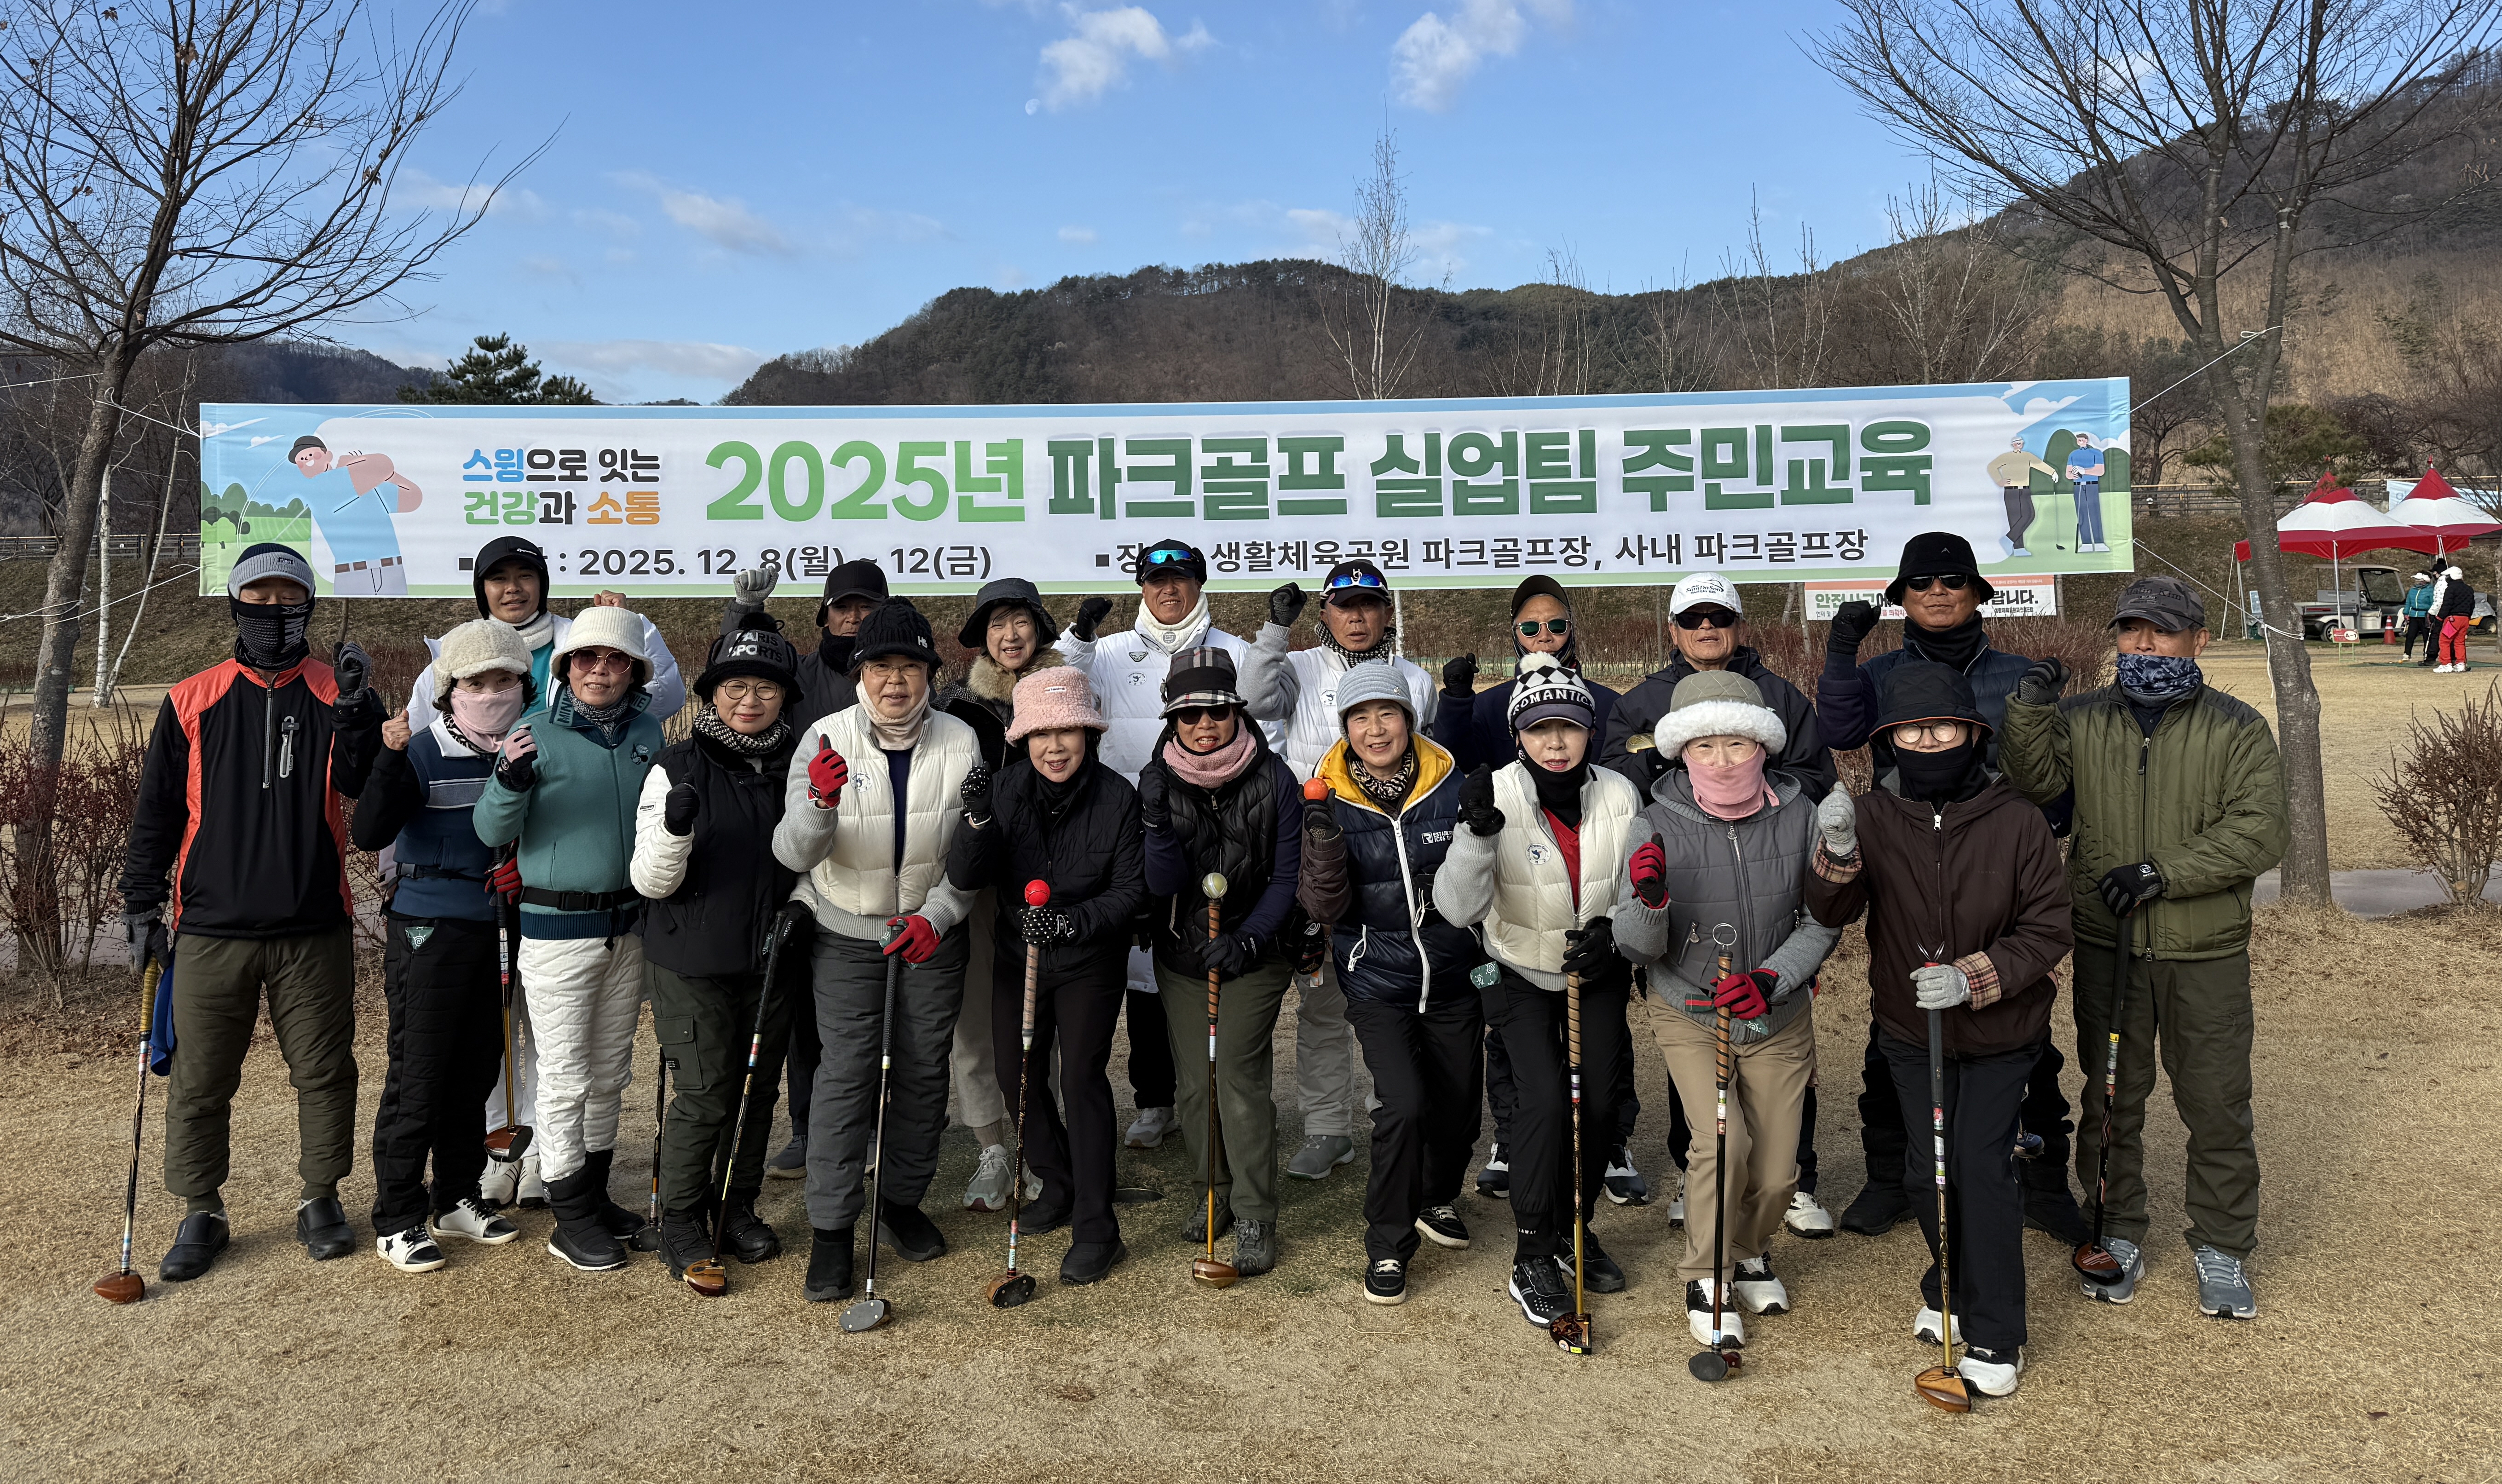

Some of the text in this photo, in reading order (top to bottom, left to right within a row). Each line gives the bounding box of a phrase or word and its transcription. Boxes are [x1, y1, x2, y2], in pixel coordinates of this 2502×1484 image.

[463, 449, 660, 483] 스윙으로 잇는
[705, 420, 1932, 523] 2025년 파크골프 실업팀 주민교육
[464, 491, 661, 525] 건강과 소통
[579, 549, 685, 575] 2025.
[760, 546, 844, 581] 8(월)
[891, 546, 991, 580] 12(금)
[1210, 539, 1409, 573] 생활체육공원
[1422, 535, 1602, 570] 파크골프장,
[1615, 534, 1682, 565] 사내
[1695, 529, 1868, 564] 파크골프장
[1982, 590, 2039, 605] 랍니다.
[727, 644, 782, 663] SPORTS
[736, 632, 778, 646] PARIS
[1513, 689, 1589, 716] ROMANTIC
